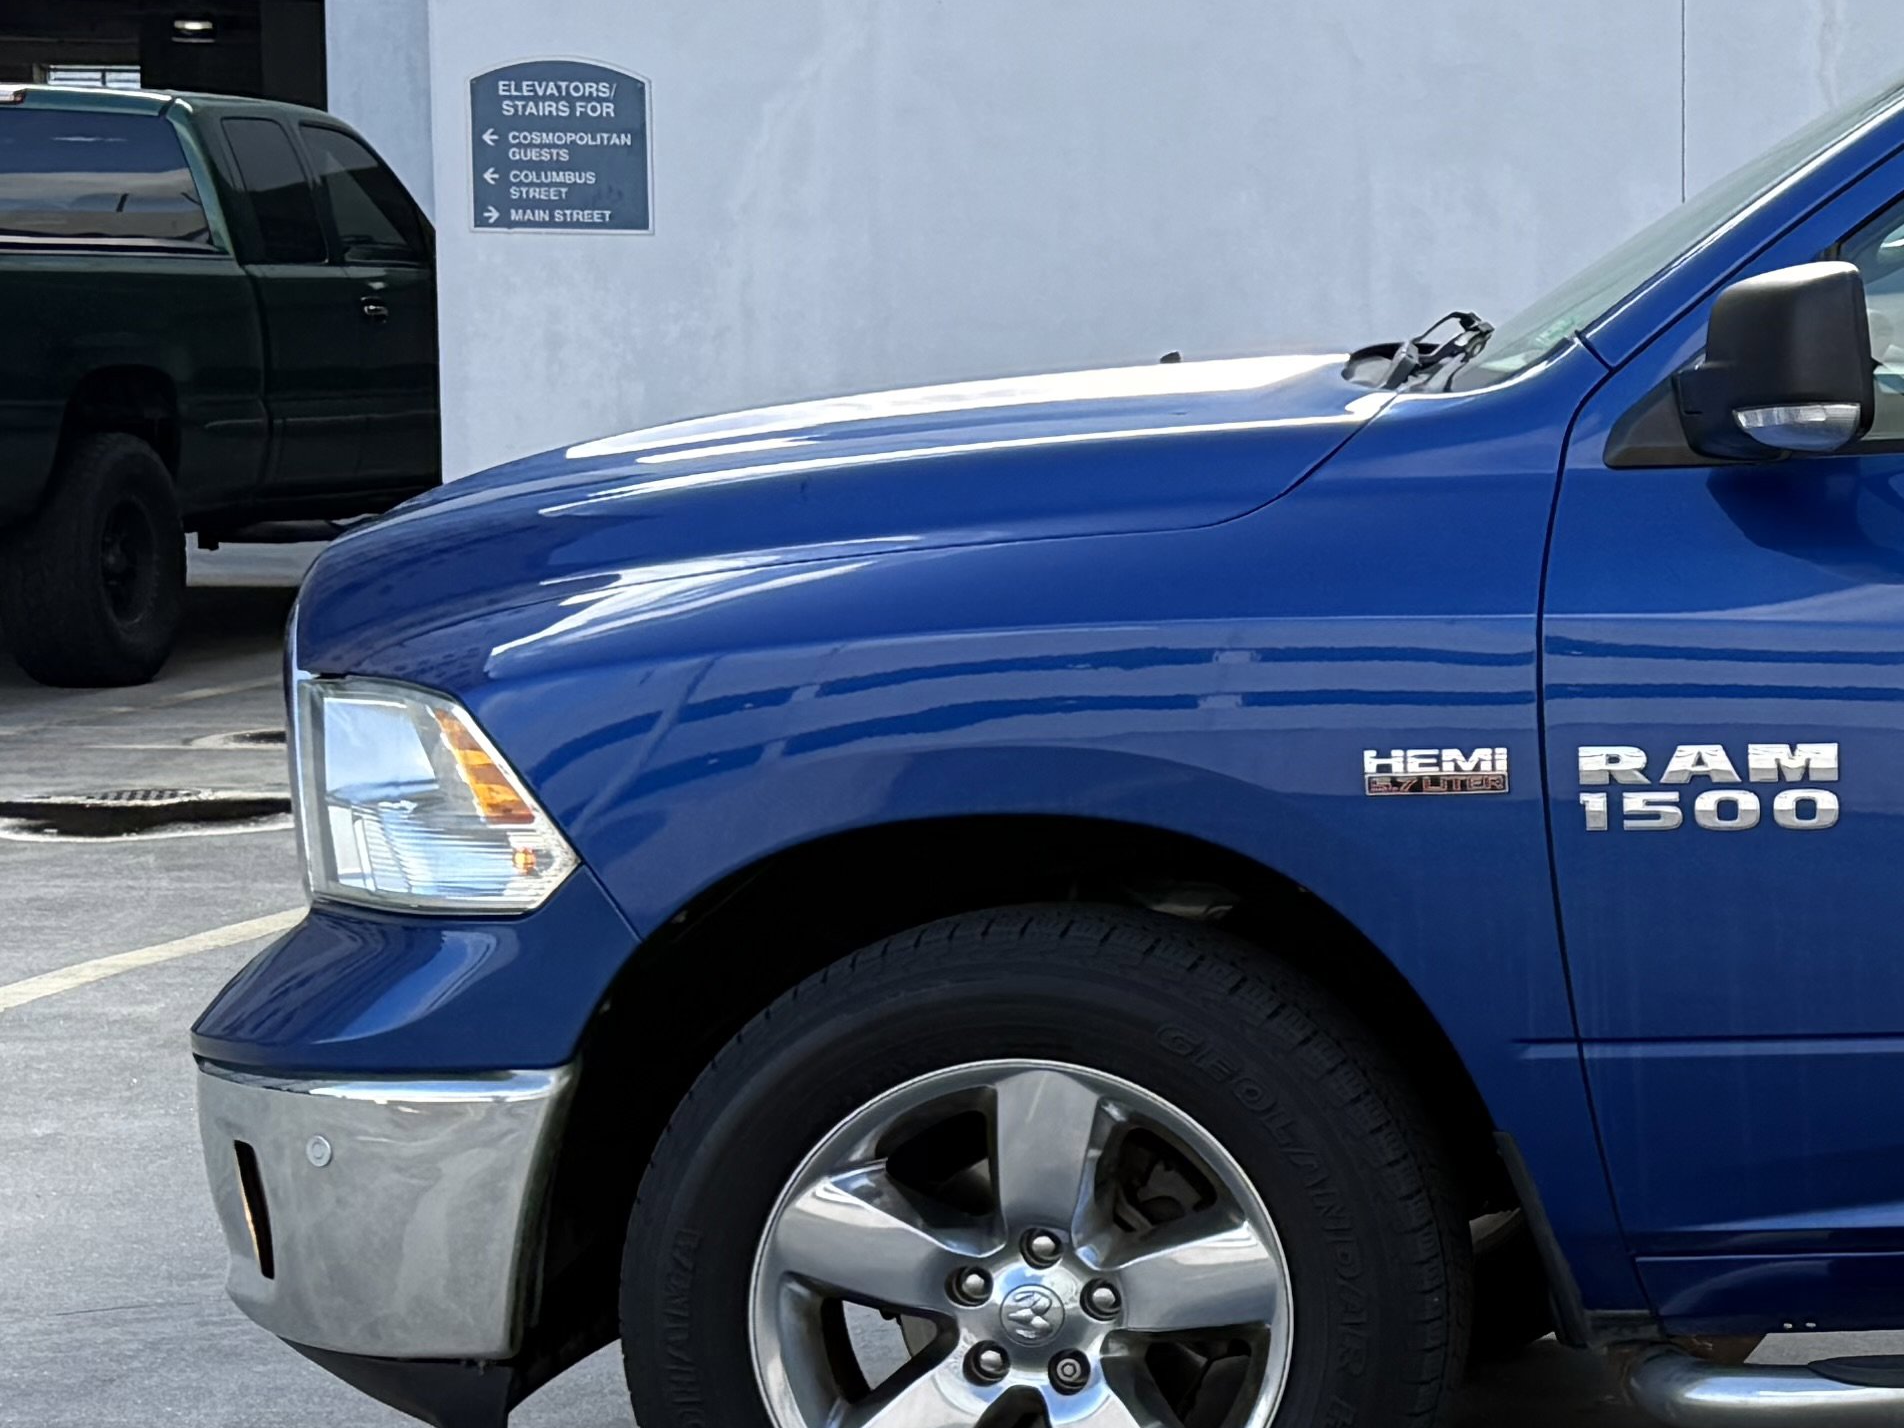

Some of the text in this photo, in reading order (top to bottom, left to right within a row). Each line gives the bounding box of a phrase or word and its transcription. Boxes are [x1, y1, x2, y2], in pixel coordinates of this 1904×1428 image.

[498, 80, 616, 99] ELEVATORS/
[502, 99, 615, 117] STAIRS FOR
[508, 131, 632, 145] COSMOPOLITAN
[508, 147, 570, 161] GUESTS
[509, 170, 596, 184] COLUMBUS
[509, 186, 569, 200] STREET
[510, 208, 612, 223] MAIN STREET
[1363, 747, 1508, 773] HEMI
[1578, 741, 1839, 785] RAM
[1370, 775, 1505, 793] 5.7 LITER
[1578, 788, 1840, 832] 1500
[1155, 1023, 1369, 1379] GEOLANDAR
